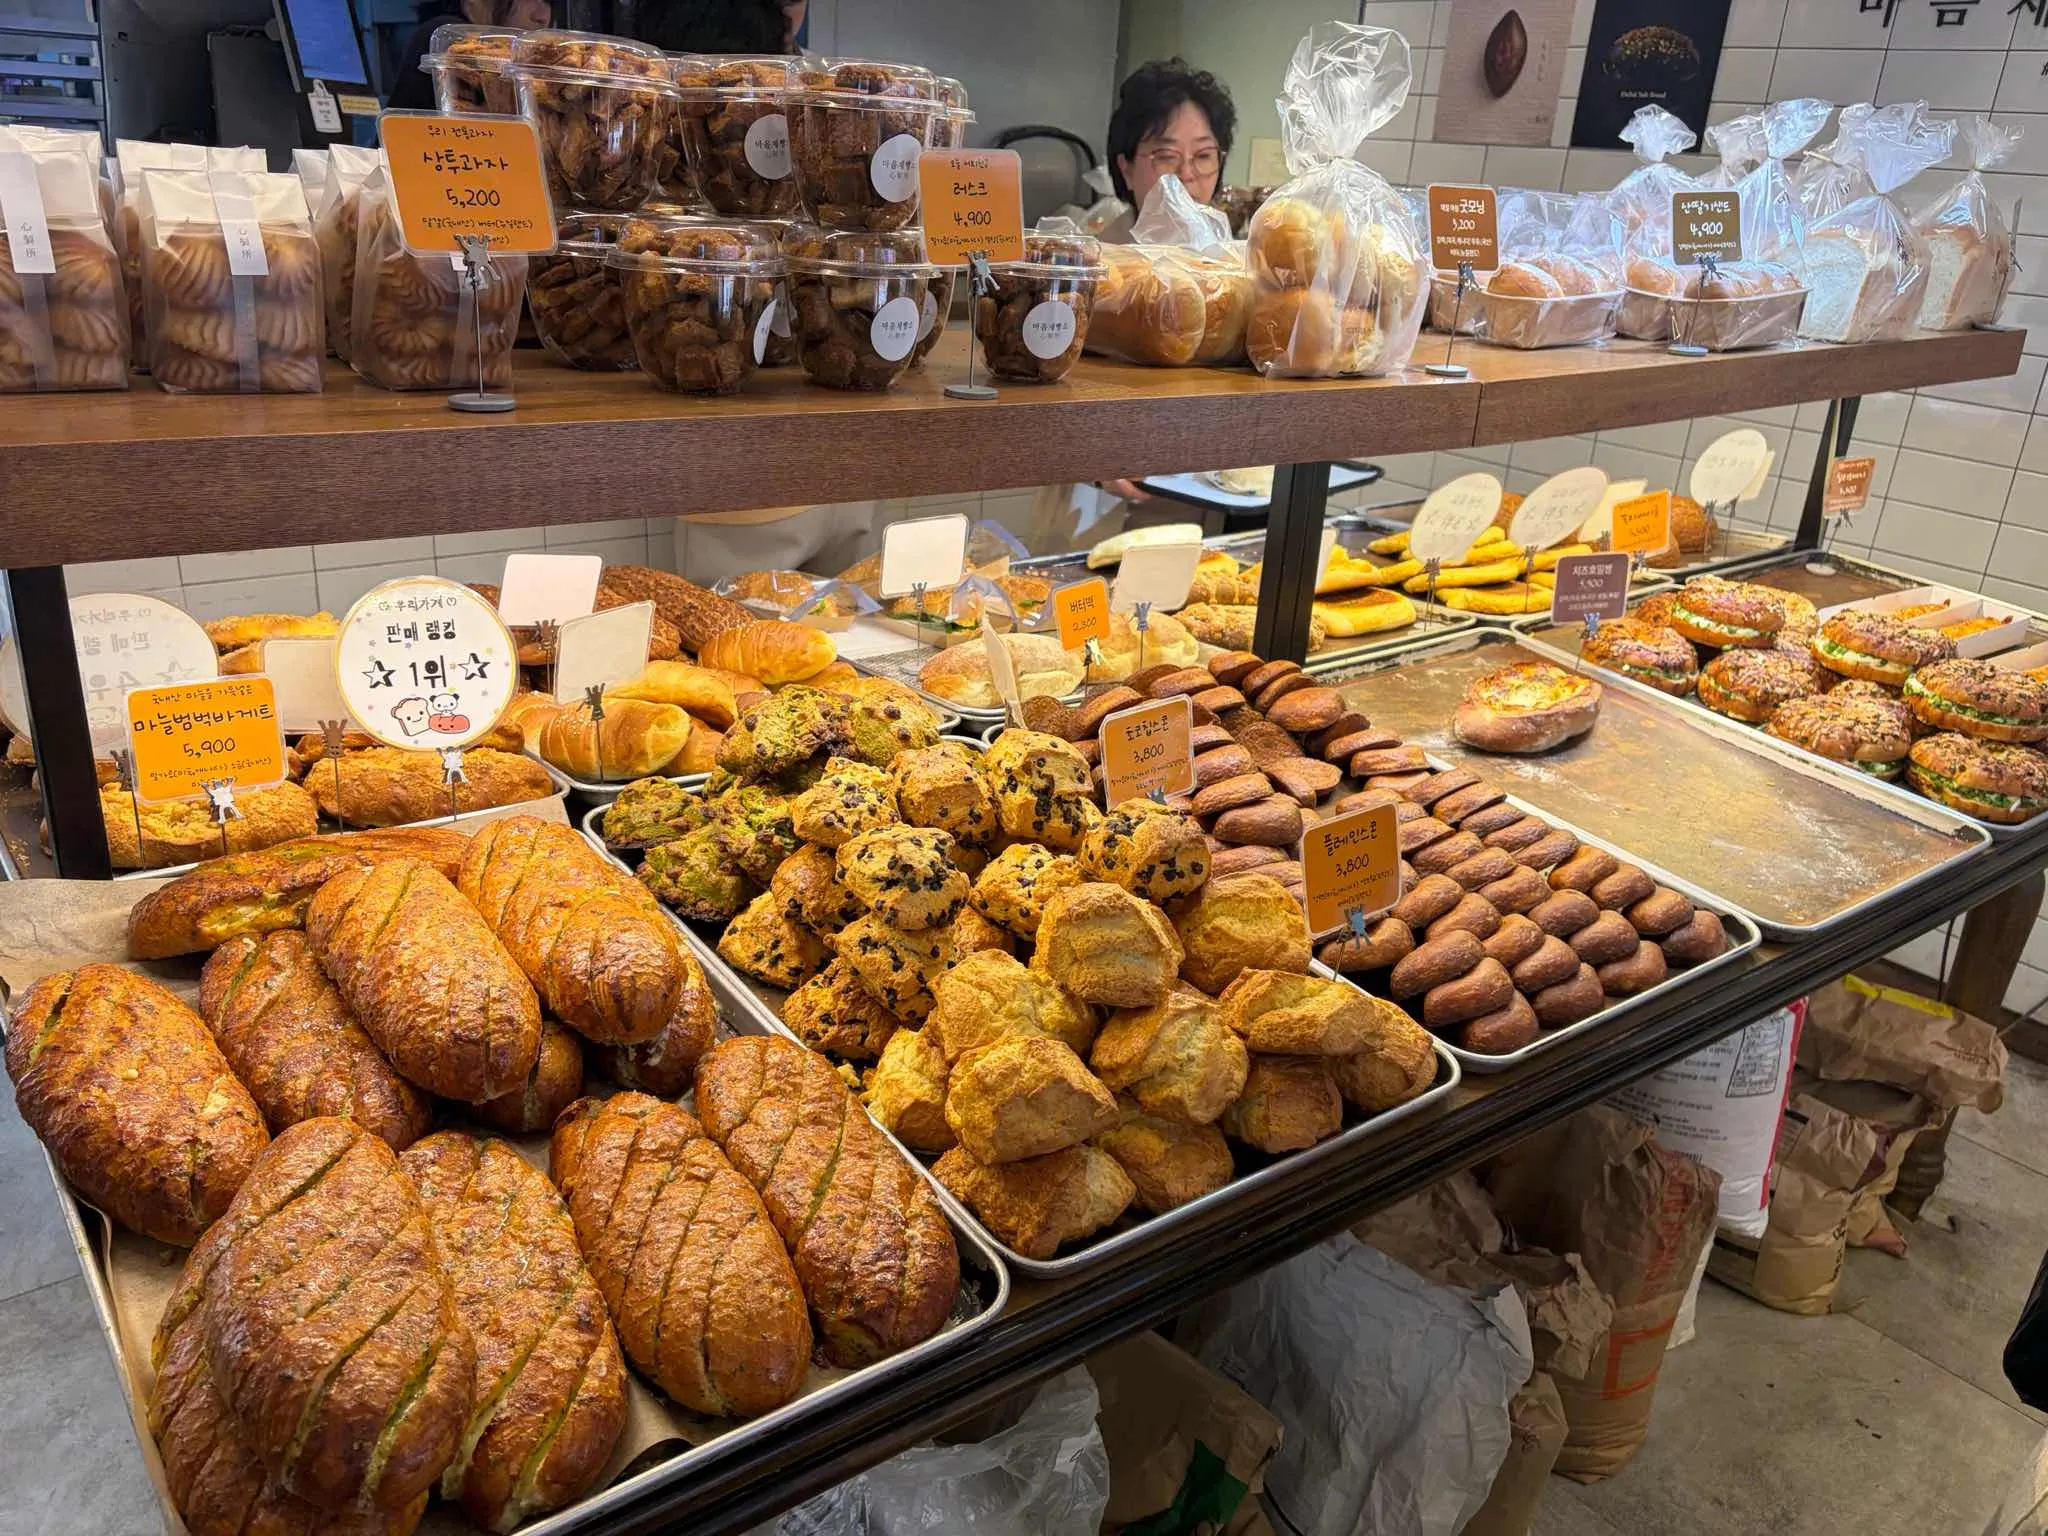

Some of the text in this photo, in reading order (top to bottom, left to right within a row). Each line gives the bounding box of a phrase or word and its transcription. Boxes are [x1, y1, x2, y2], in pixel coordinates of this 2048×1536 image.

[423, 149, 510, 175] 상투과자
[446, 188, 501, 209] 5,200
[953, 181, 988, 196] 러스크
[1460, 198, 1485, 215] 굿모닝
[953, 210, 992, 227] 4,900
[1690, 221, 1723, 238] 4,900
[394, 594, 444, 612] 우리가게
[386, 618, 457, 644] 판매 랭킹
[408, 654, 448, 689] 1위
[152, 693, 181, 705] 국내산
[134, 703, 274, 736] 마늘범벅바게트
[1125, 714, 1169, 742] 초코칩스콘
[183, 737, 236, 758] 5,900
[1133, 743, 1165, 764] 3,800
[1323, 820, 1378, 857] 플레인스콘
[1335, 853, 1370, 878] 3,800
